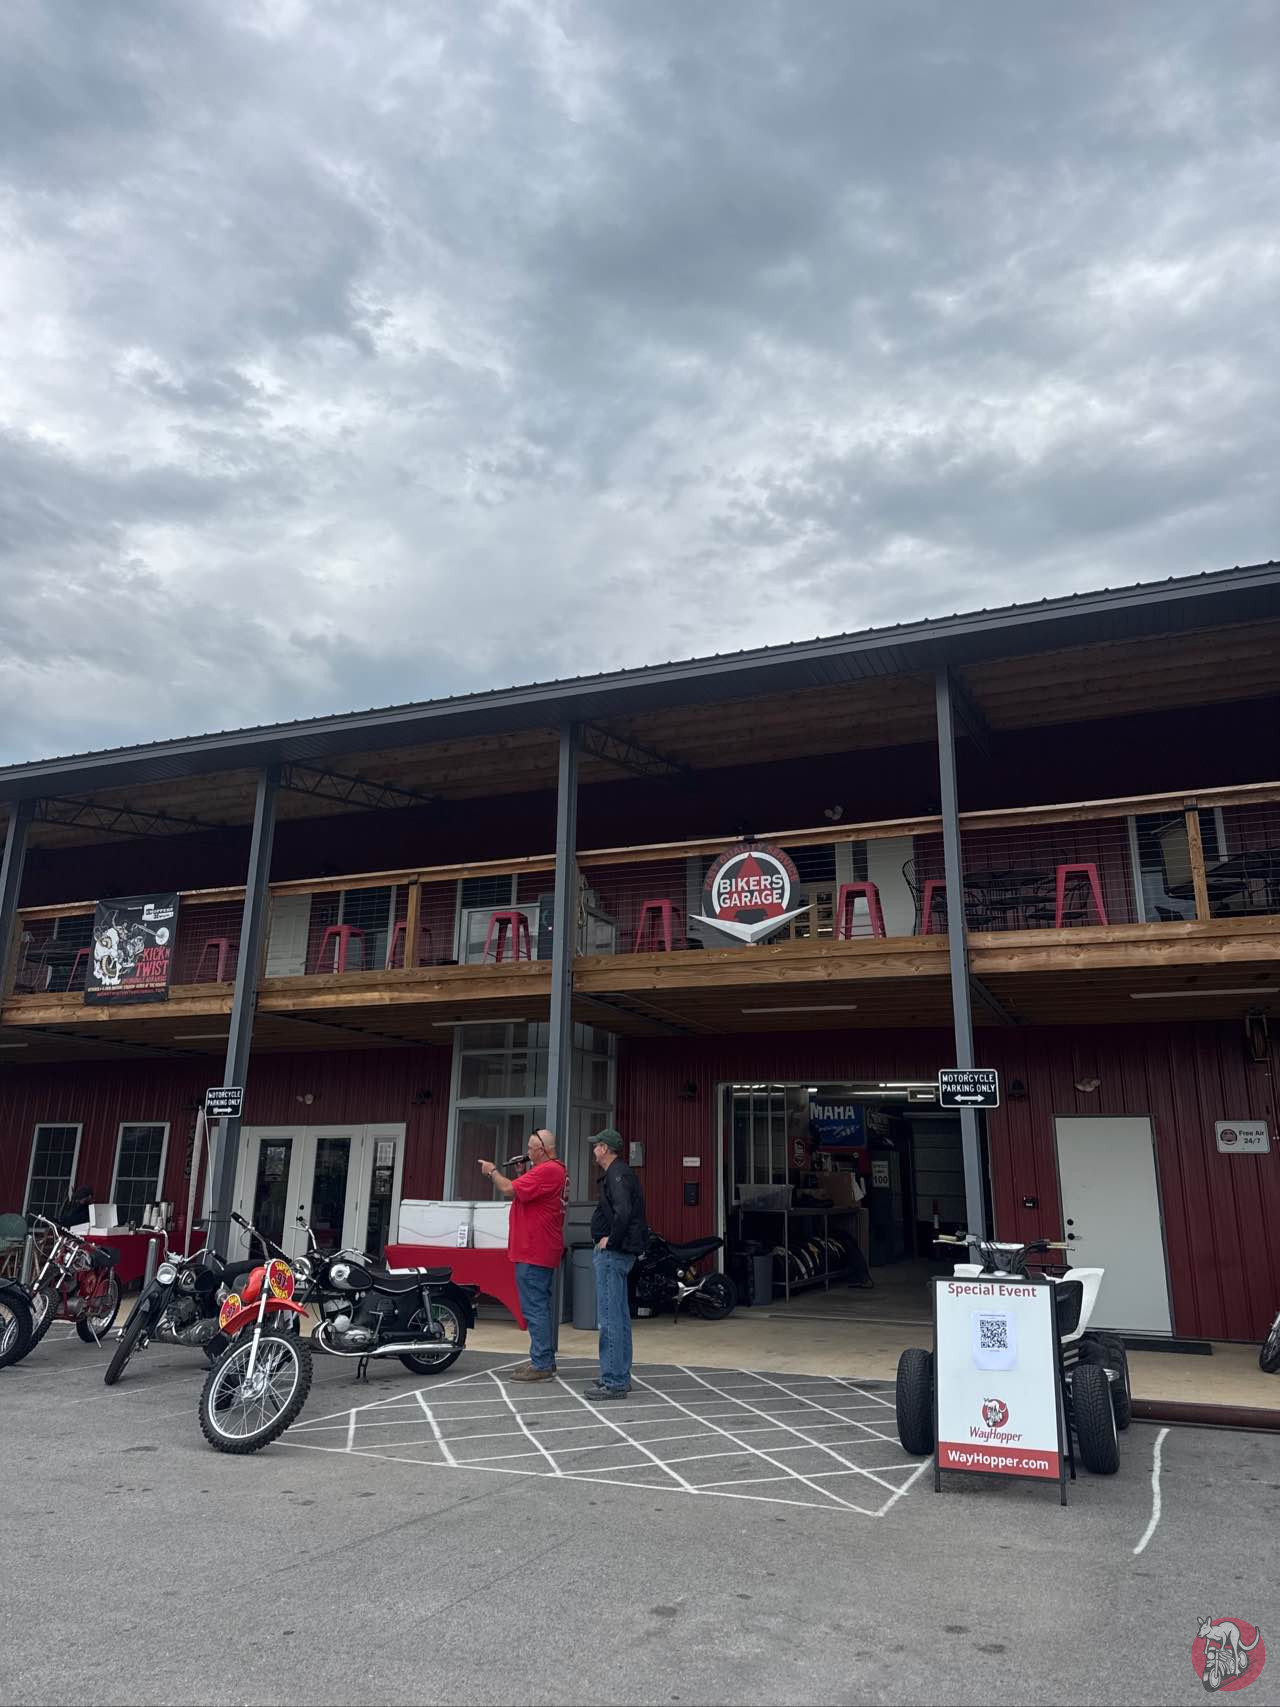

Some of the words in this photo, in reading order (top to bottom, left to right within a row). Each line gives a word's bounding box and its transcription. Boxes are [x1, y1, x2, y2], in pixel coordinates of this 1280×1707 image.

[719, 874, 783, 893] BIKERS
[719, 890, 782, 908] GARAGE
[143, 946, 166, 961] KICK
[135, 960, 169, 977] TWIST
[942, 1074, 995, 1083] MOTORCYCLE
[208, 1091, 241, 1099] MOTORCYCLE
[942, 1084, 975, 1093] PARKING
[976, 1084, 996, 1093] ONLY
[809, 1102, 855, 1120] MAHA
[1244, 1137, 1260, 1145] 24/7
[874, 1175, 889, 1185] 100
[947, 1283, 995, 1297] Special
[999, 1285, 1038, 1298] Event
[969, 1426, 1023, 1444] WayHopper
[947, 1449, 1050, 1471] WayHopper.com
